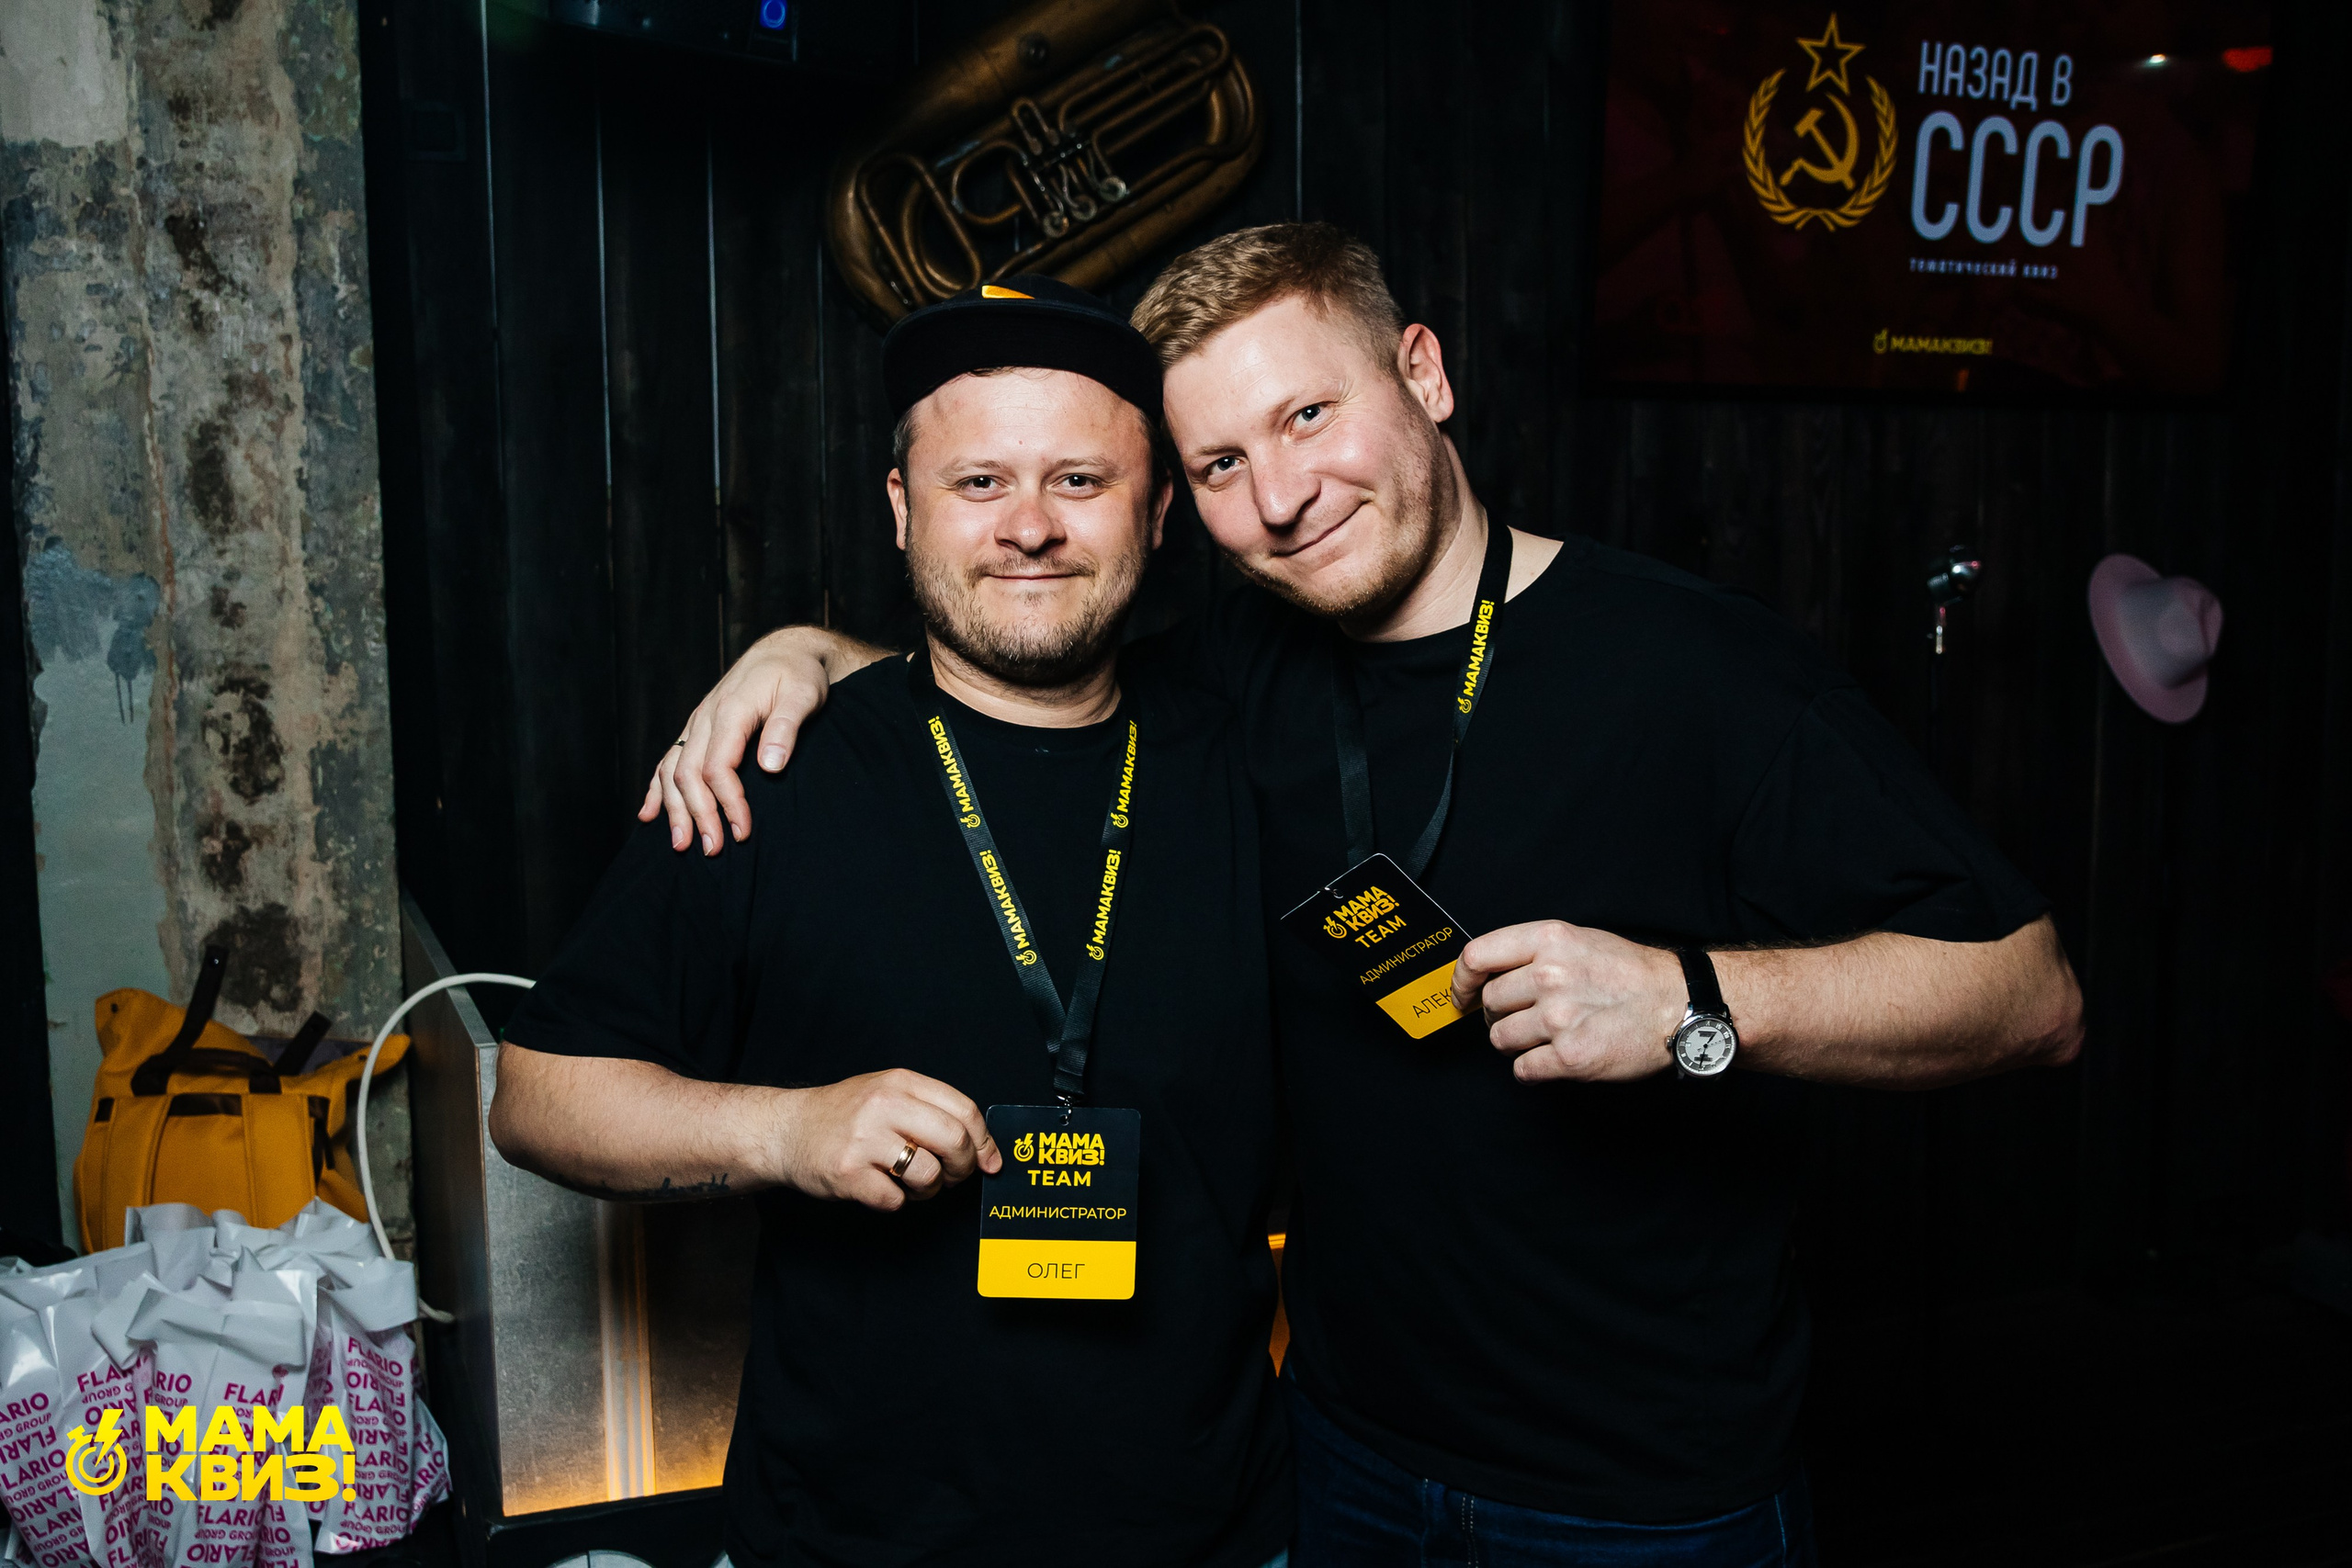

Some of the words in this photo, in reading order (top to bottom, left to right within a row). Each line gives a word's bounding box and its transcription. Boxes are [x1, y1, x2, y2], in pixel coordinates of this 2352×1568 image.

[1918, 40, 2039, 112] НАЗАД
[2051, 53, 2074, 107] В
[1910, 110, 2125, 248] СССР
[1463, 599, 1495, 697] МАМАКВИЗ!
[928, 716, 974, 813] МАМАКВИЗ!
[1116, 719, 1137, 813] МАМАКВИЗ!
[978, 849, 1030, 950] МАМАКВИЗ!
[1092, 849, 1122, 944] МАМАКВИЗ!
[1333, 886, 1388, 921] МАМА
[1345, 895, 1400, 931] КВИЗ!
[1354, 915, 1407, 948] TEAM
[1360, 926, 1453, 985] АДМИНИСТРАТОР
[1412, 986, 1453, 1019] АЛЕК
[1038, 1132, 1104, 1150] МАМА
[1038, 1148, 1105, 1166] КВИЗ!
[1027, 1169, 1091, 1187] TEAM
[989, 1205, 1127, 1220] АДМИНИСТРАТОР
[1027, 1262, 1086, 1280] ОЛЕГ
